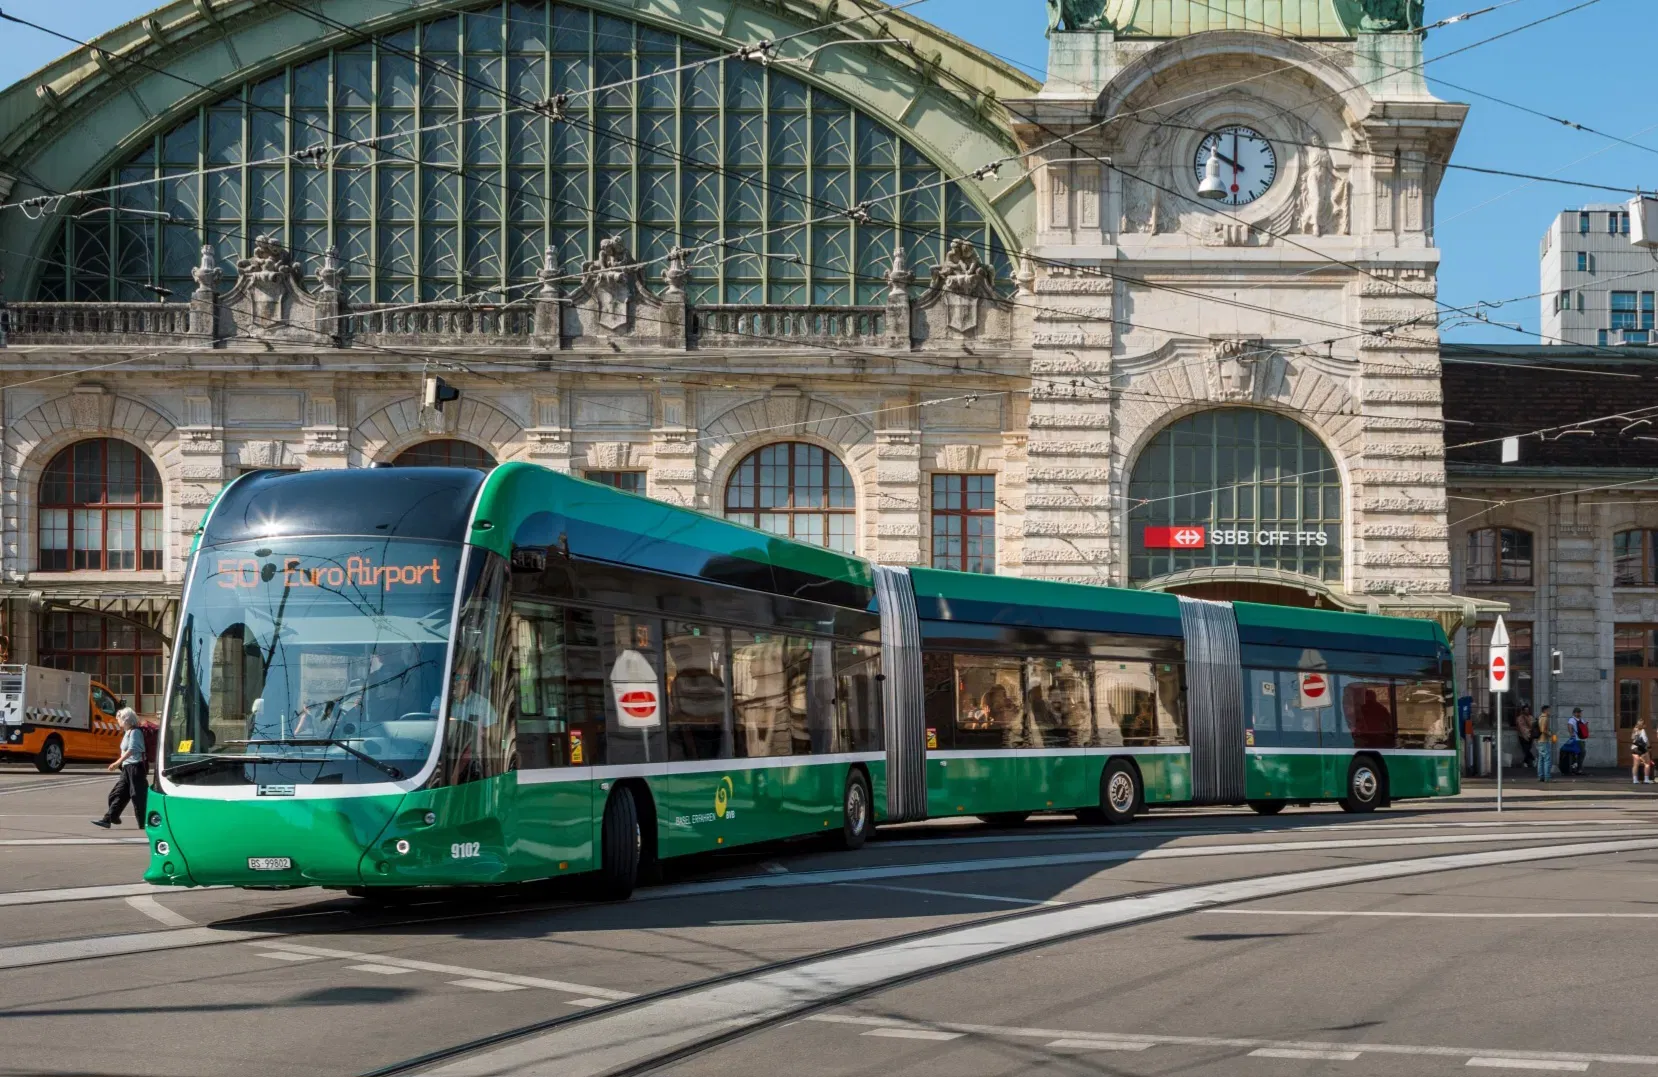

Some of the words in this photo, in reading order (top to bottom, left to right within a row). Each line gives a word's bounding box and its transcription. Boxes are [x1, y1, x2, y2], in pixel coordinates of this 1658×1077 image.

[1211, 529, 1250, 545] SBB
[1256, 530, 1290, 546] CFF
[1296, 531, 1328, 547] FFS
[217, 559, 259, 588] 50
[283, 556, 441, 591] EuroAirport
[675, 815, 691, 825] BASEL
[451, 841, 480, 858] 9102
